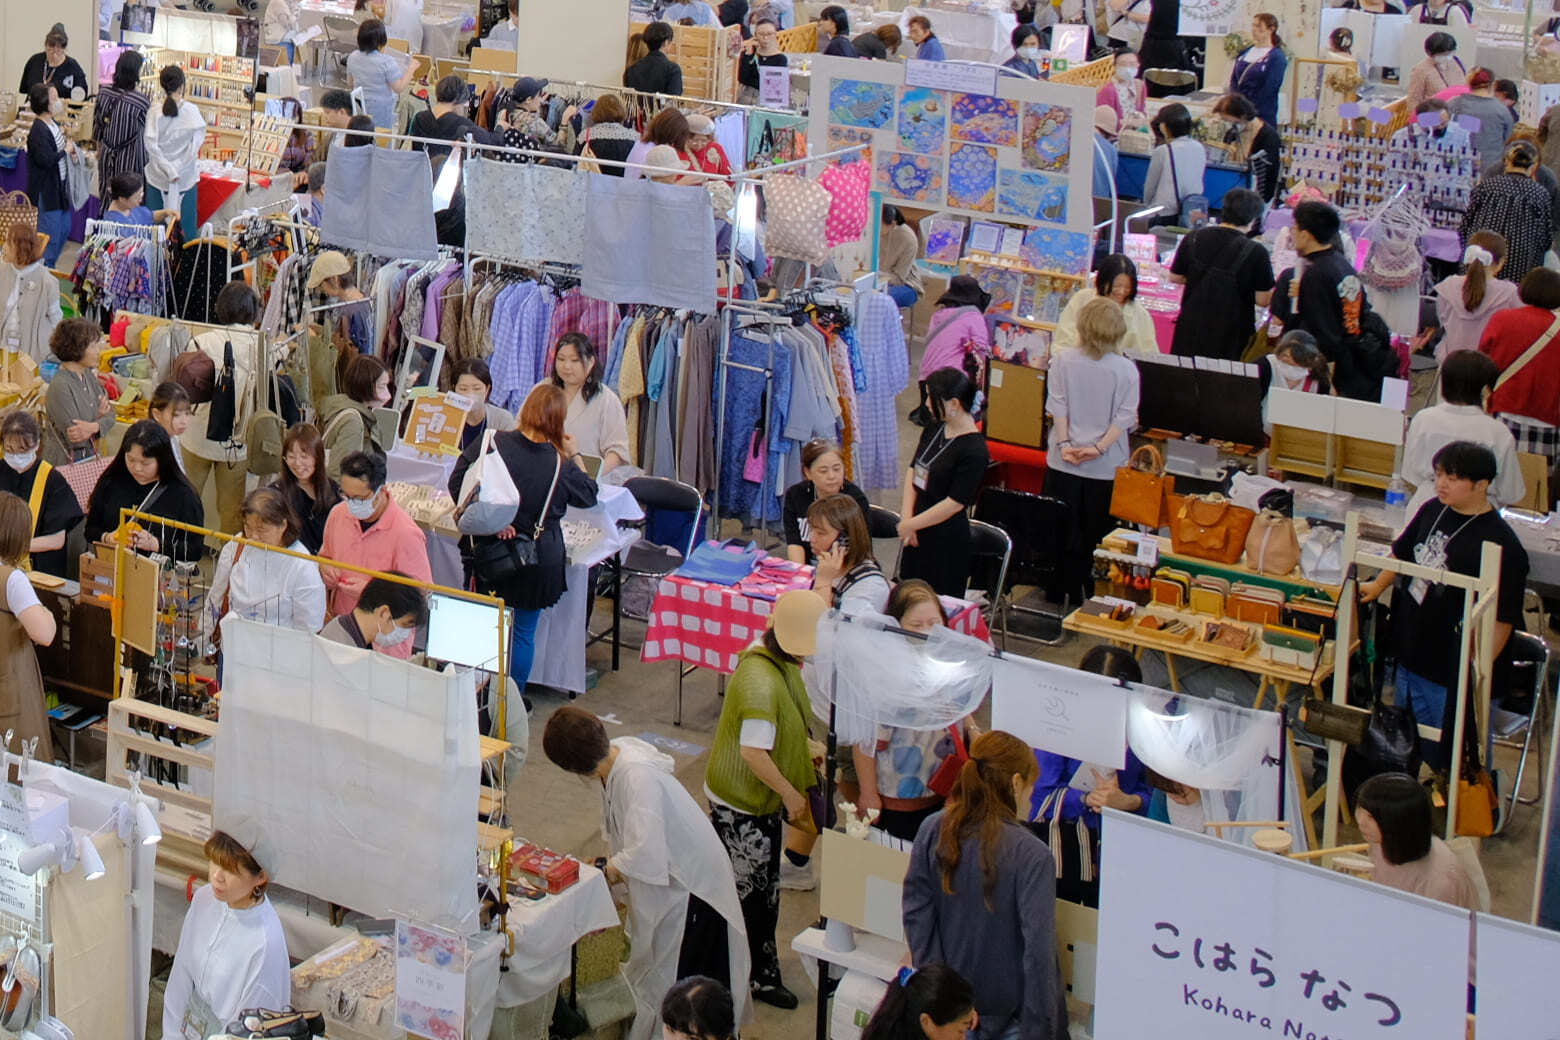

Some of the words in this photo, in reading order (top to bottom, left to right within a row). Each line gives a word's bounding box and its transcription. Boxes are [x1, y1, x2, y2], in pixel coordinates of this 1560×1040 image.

[1152, 922, 1276, 988] こはら
[1300, 969, 1402, 1026] なつ
[1183, 983, 1272, 1030] Kohara
